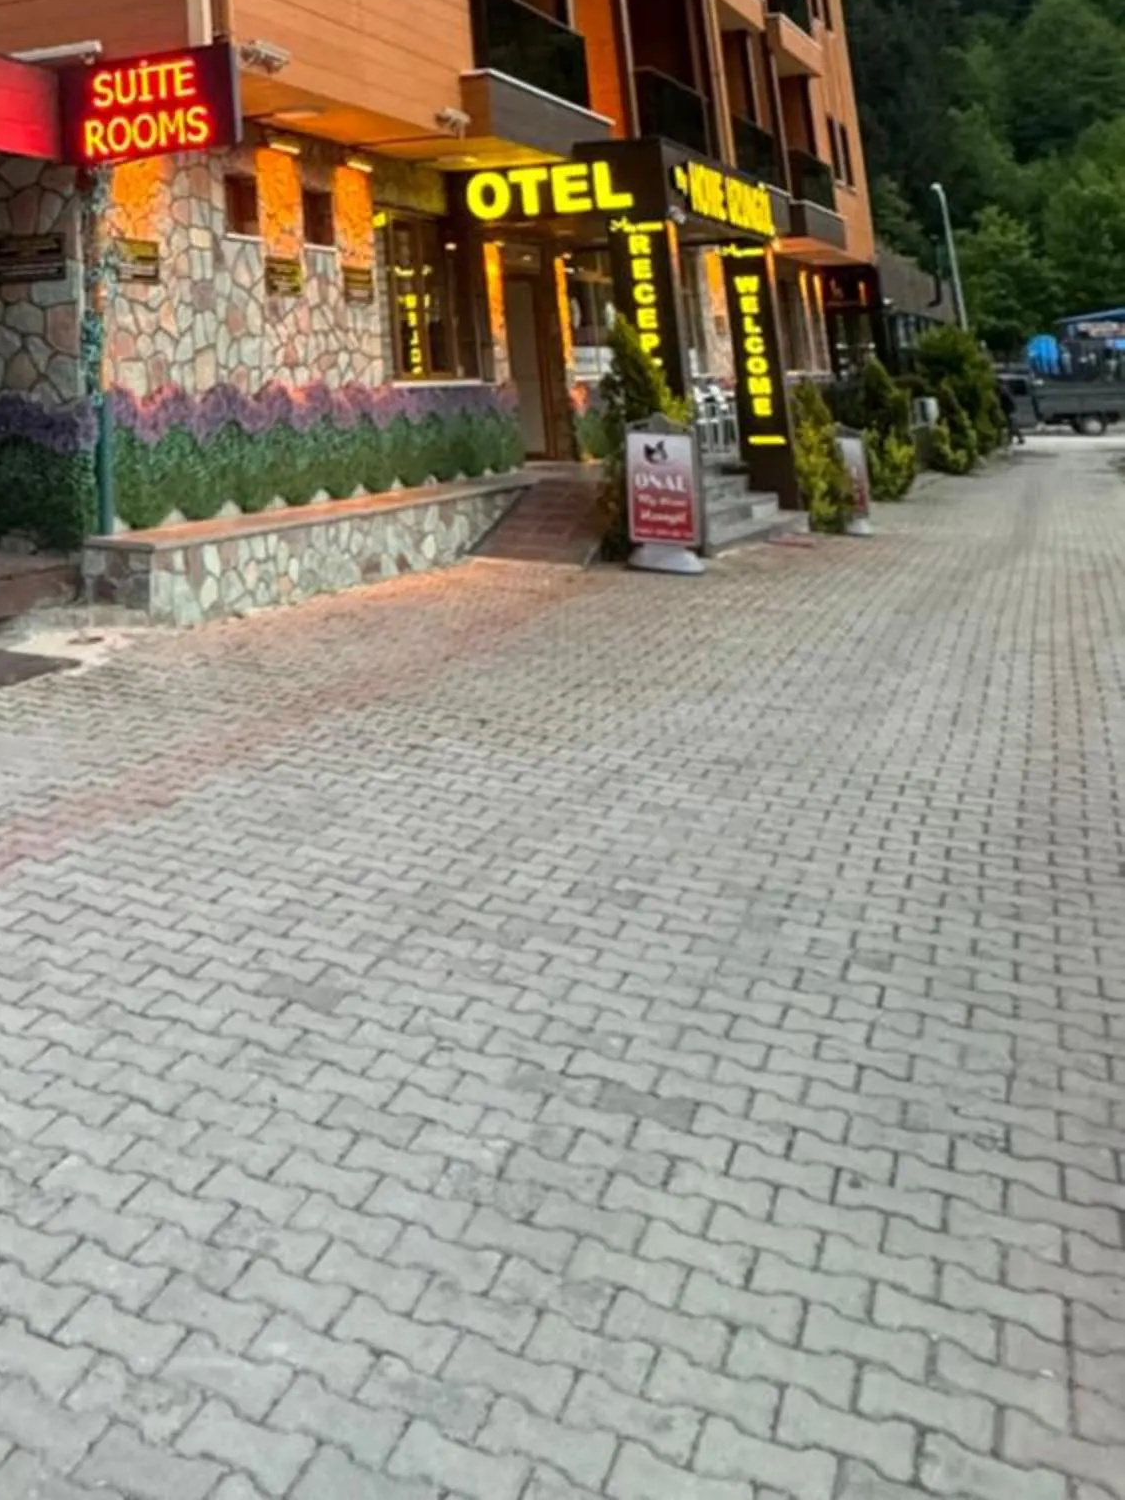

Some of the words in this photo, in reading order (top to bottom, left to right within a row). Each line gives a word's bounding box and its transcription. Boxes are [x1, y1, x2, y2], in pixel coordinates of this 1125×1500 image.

[84, 105, 210, 158] ROOMS
[465, 160, 634, 220] OTEL
[734, 275, 773, 417] WELCOME
